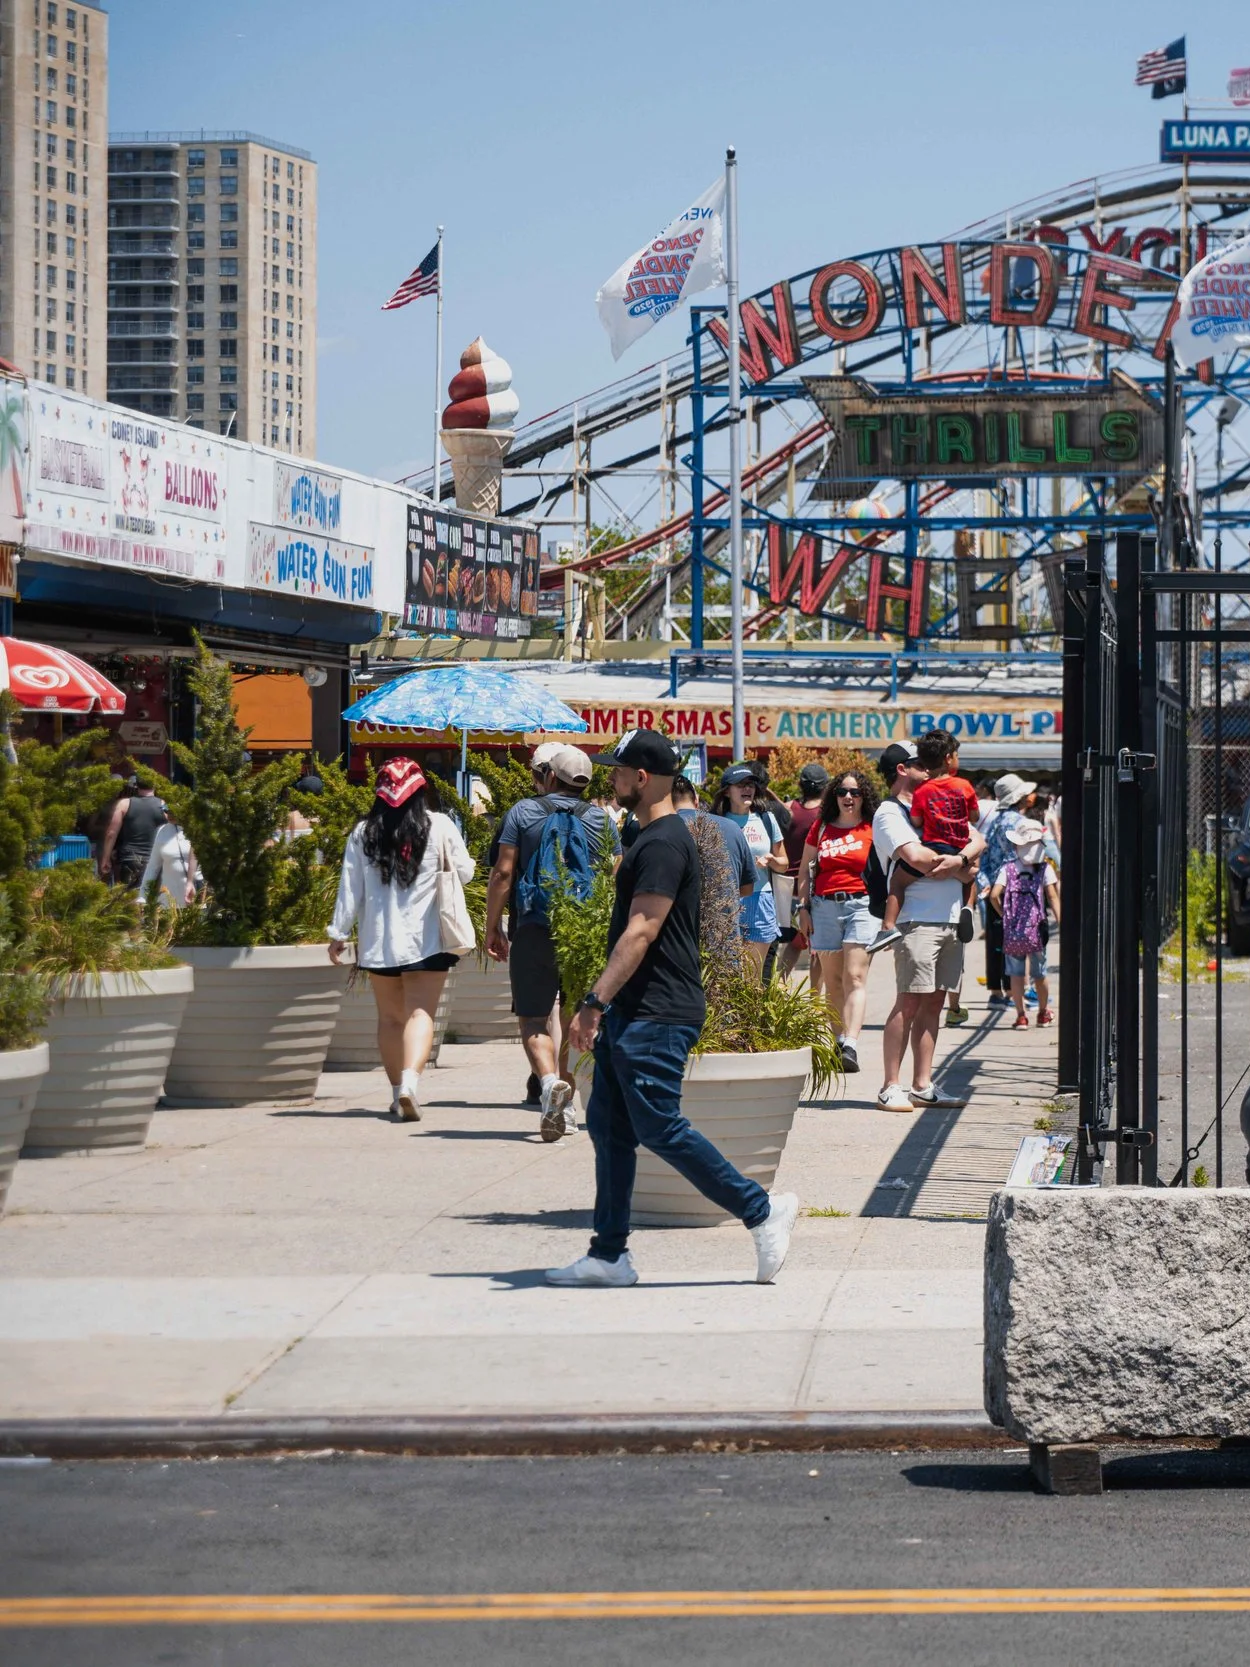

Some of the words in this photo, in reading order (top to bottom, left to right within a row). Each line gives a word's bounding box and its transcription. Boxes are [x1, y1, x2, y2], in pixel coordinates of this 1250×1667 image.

[1170, 126, 1231, 147] LUNA
[708, 242, 1217, 384] WONDE
[111, 420, 134, 442] CONEY
[135, 426, 158, 449] ISLAND
[846, 411, 1140, 465] THRILLS
[165, 460, 218, 511] BALLOONS
[291, 476, 312, 520] WATER
[314, 482, 327, 531] GUN
[328, 489, 341, 531] FUN
[277, 541, 318, 585] WATER
[323, 550, 346, 600] GUN
[351, 560, 373, 602] FUN
[757, 716, 772, 733] &
[776, 711, 900, 739] ARCHERY
